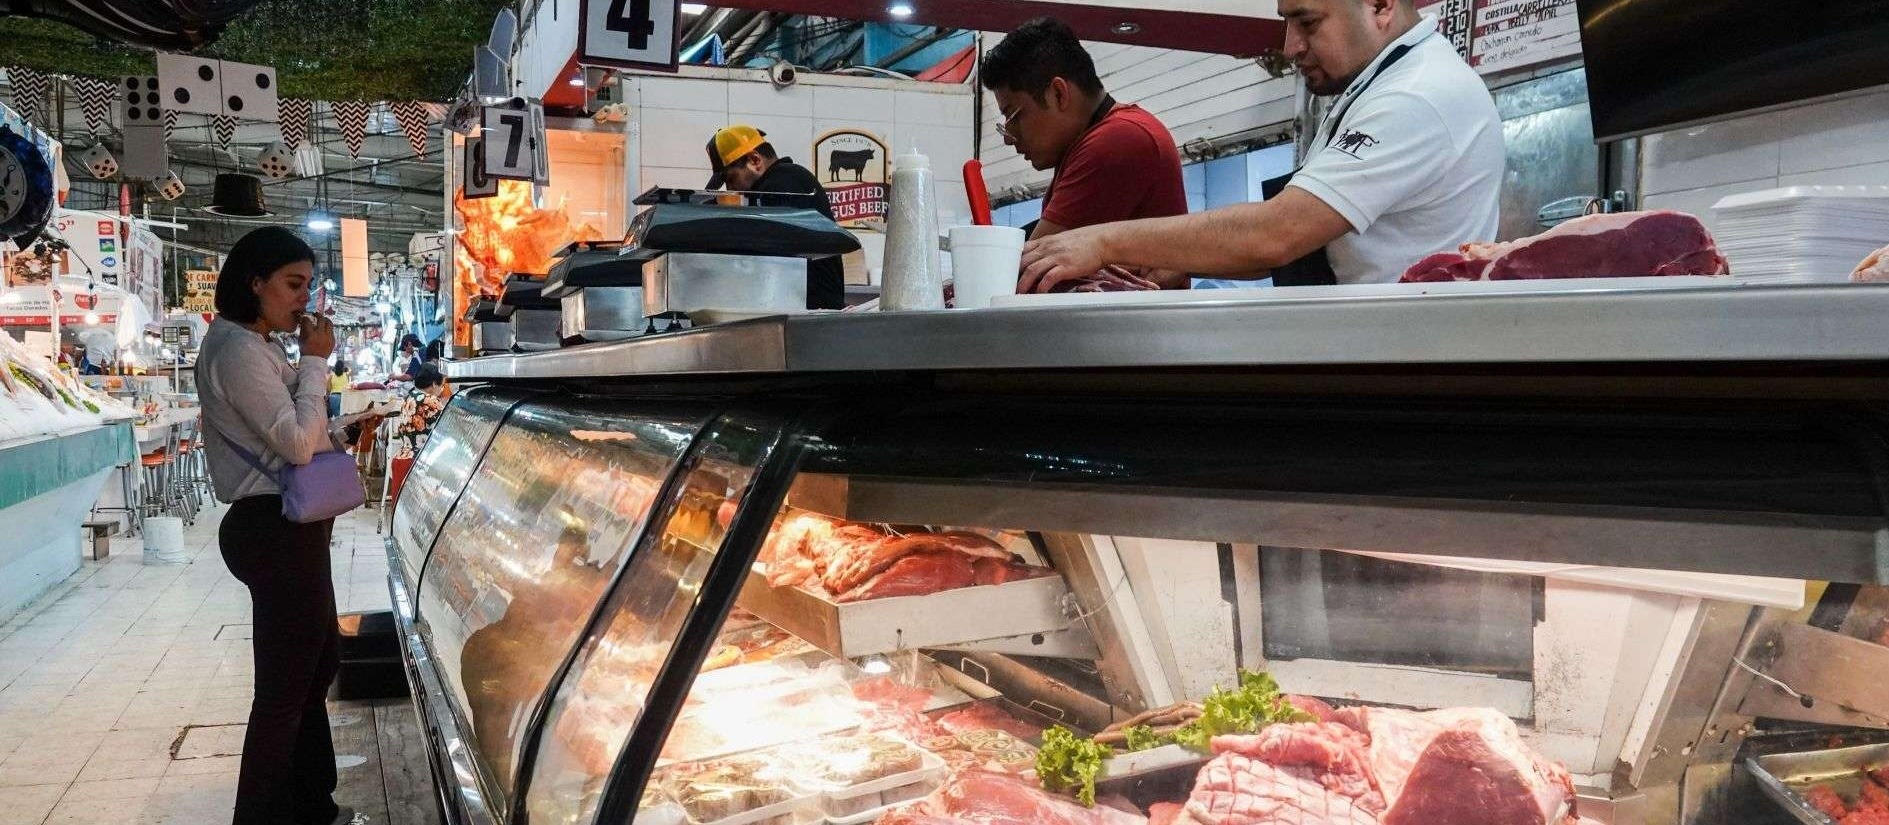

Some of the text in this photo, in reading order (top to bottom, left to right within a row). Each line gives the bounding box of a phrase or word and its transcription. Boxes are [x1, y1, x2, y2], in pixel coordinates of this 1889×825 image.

[606, 0, 654, 50] 4
[1447, 13, 1467, 35] 210
[500, 115, 523, 168] 7
[826, 186, 884, 204] ERTIFIED
[830, 201, 888, 218] GUS BEEF
[197, 282, 217, 290] SUAV
